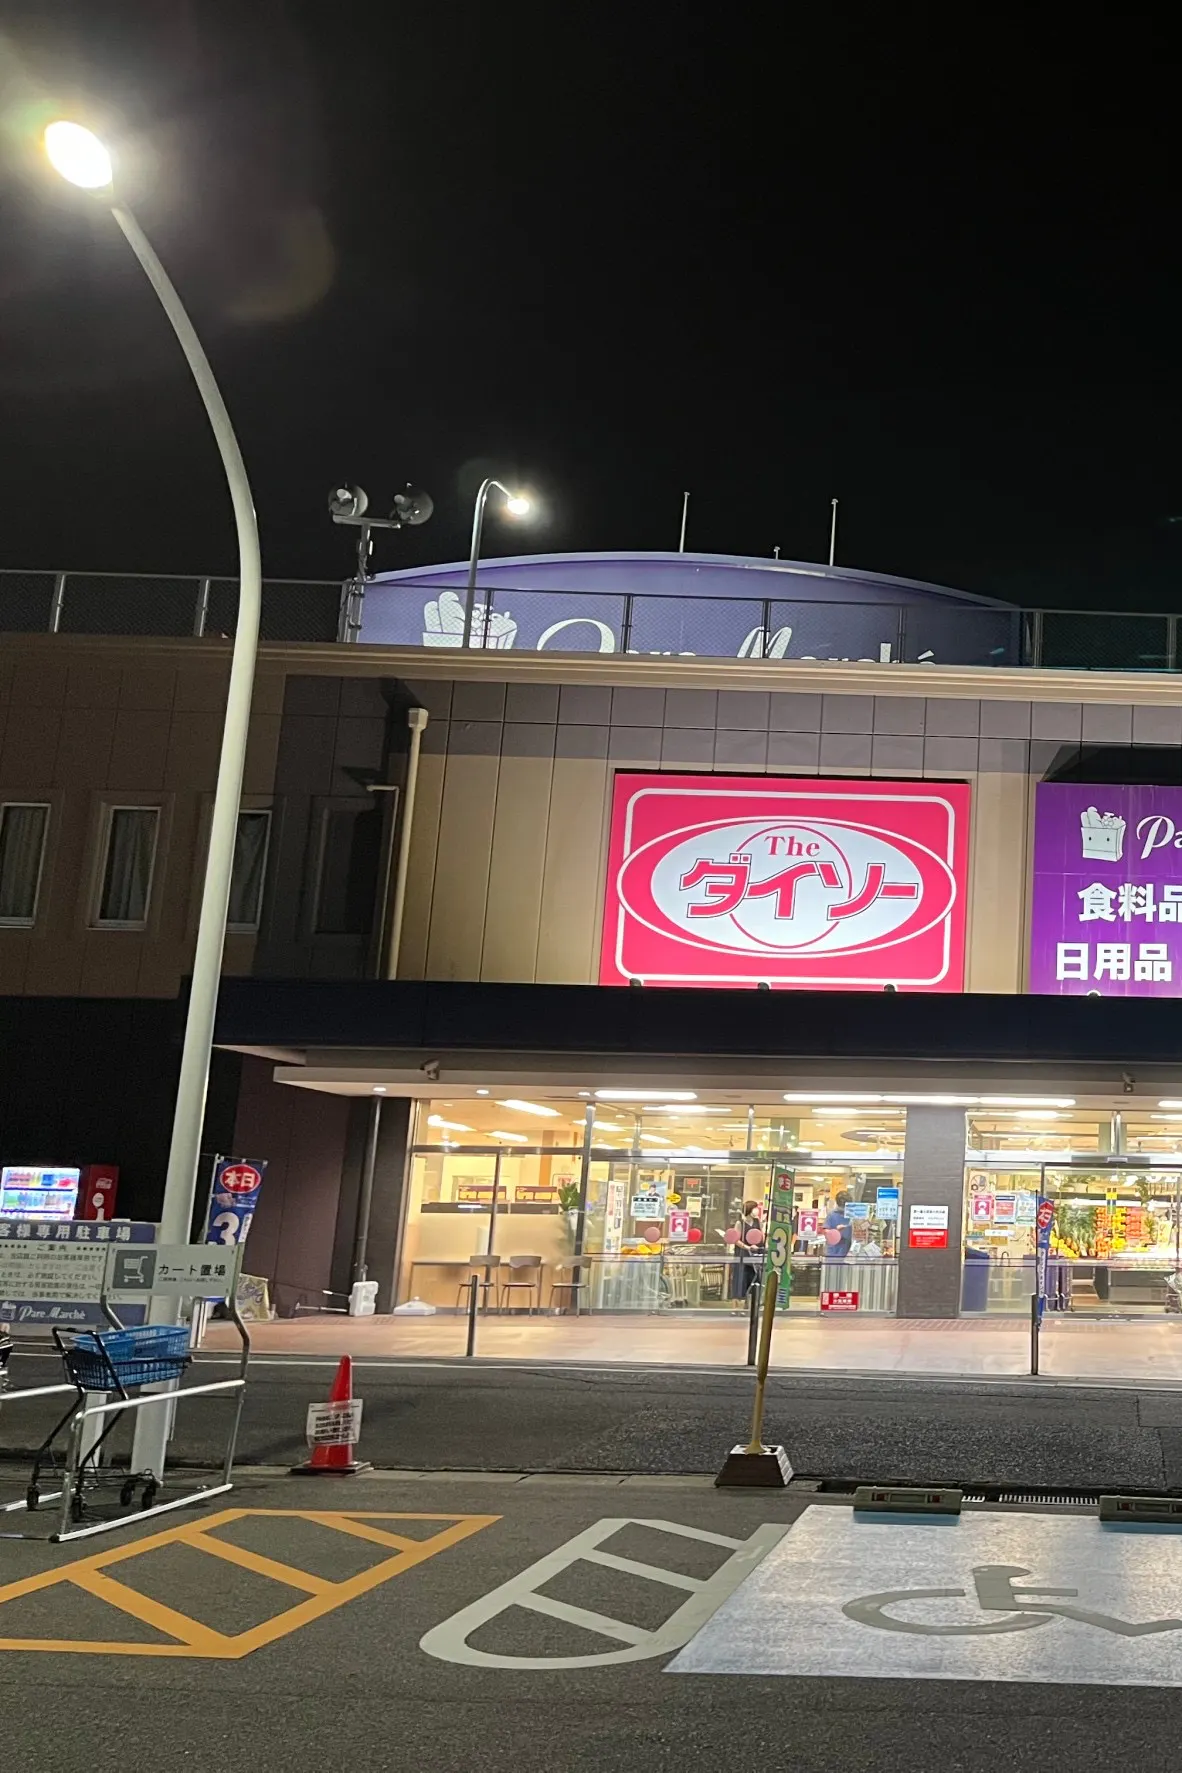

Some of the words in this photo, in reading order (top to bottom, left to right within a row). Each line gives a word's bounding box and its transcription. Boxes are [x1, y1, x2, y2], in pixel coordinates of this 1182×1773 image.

[764, 835, 820, 857] The
[679, 853, 919, 920] ダイソー
[224, 1170, 256, 1188] 本日
[771, 1227, 787, 1267] 3
[158, 1264, 226, 1276] カート置場
[19, 1306, 46, 1321] Pare
